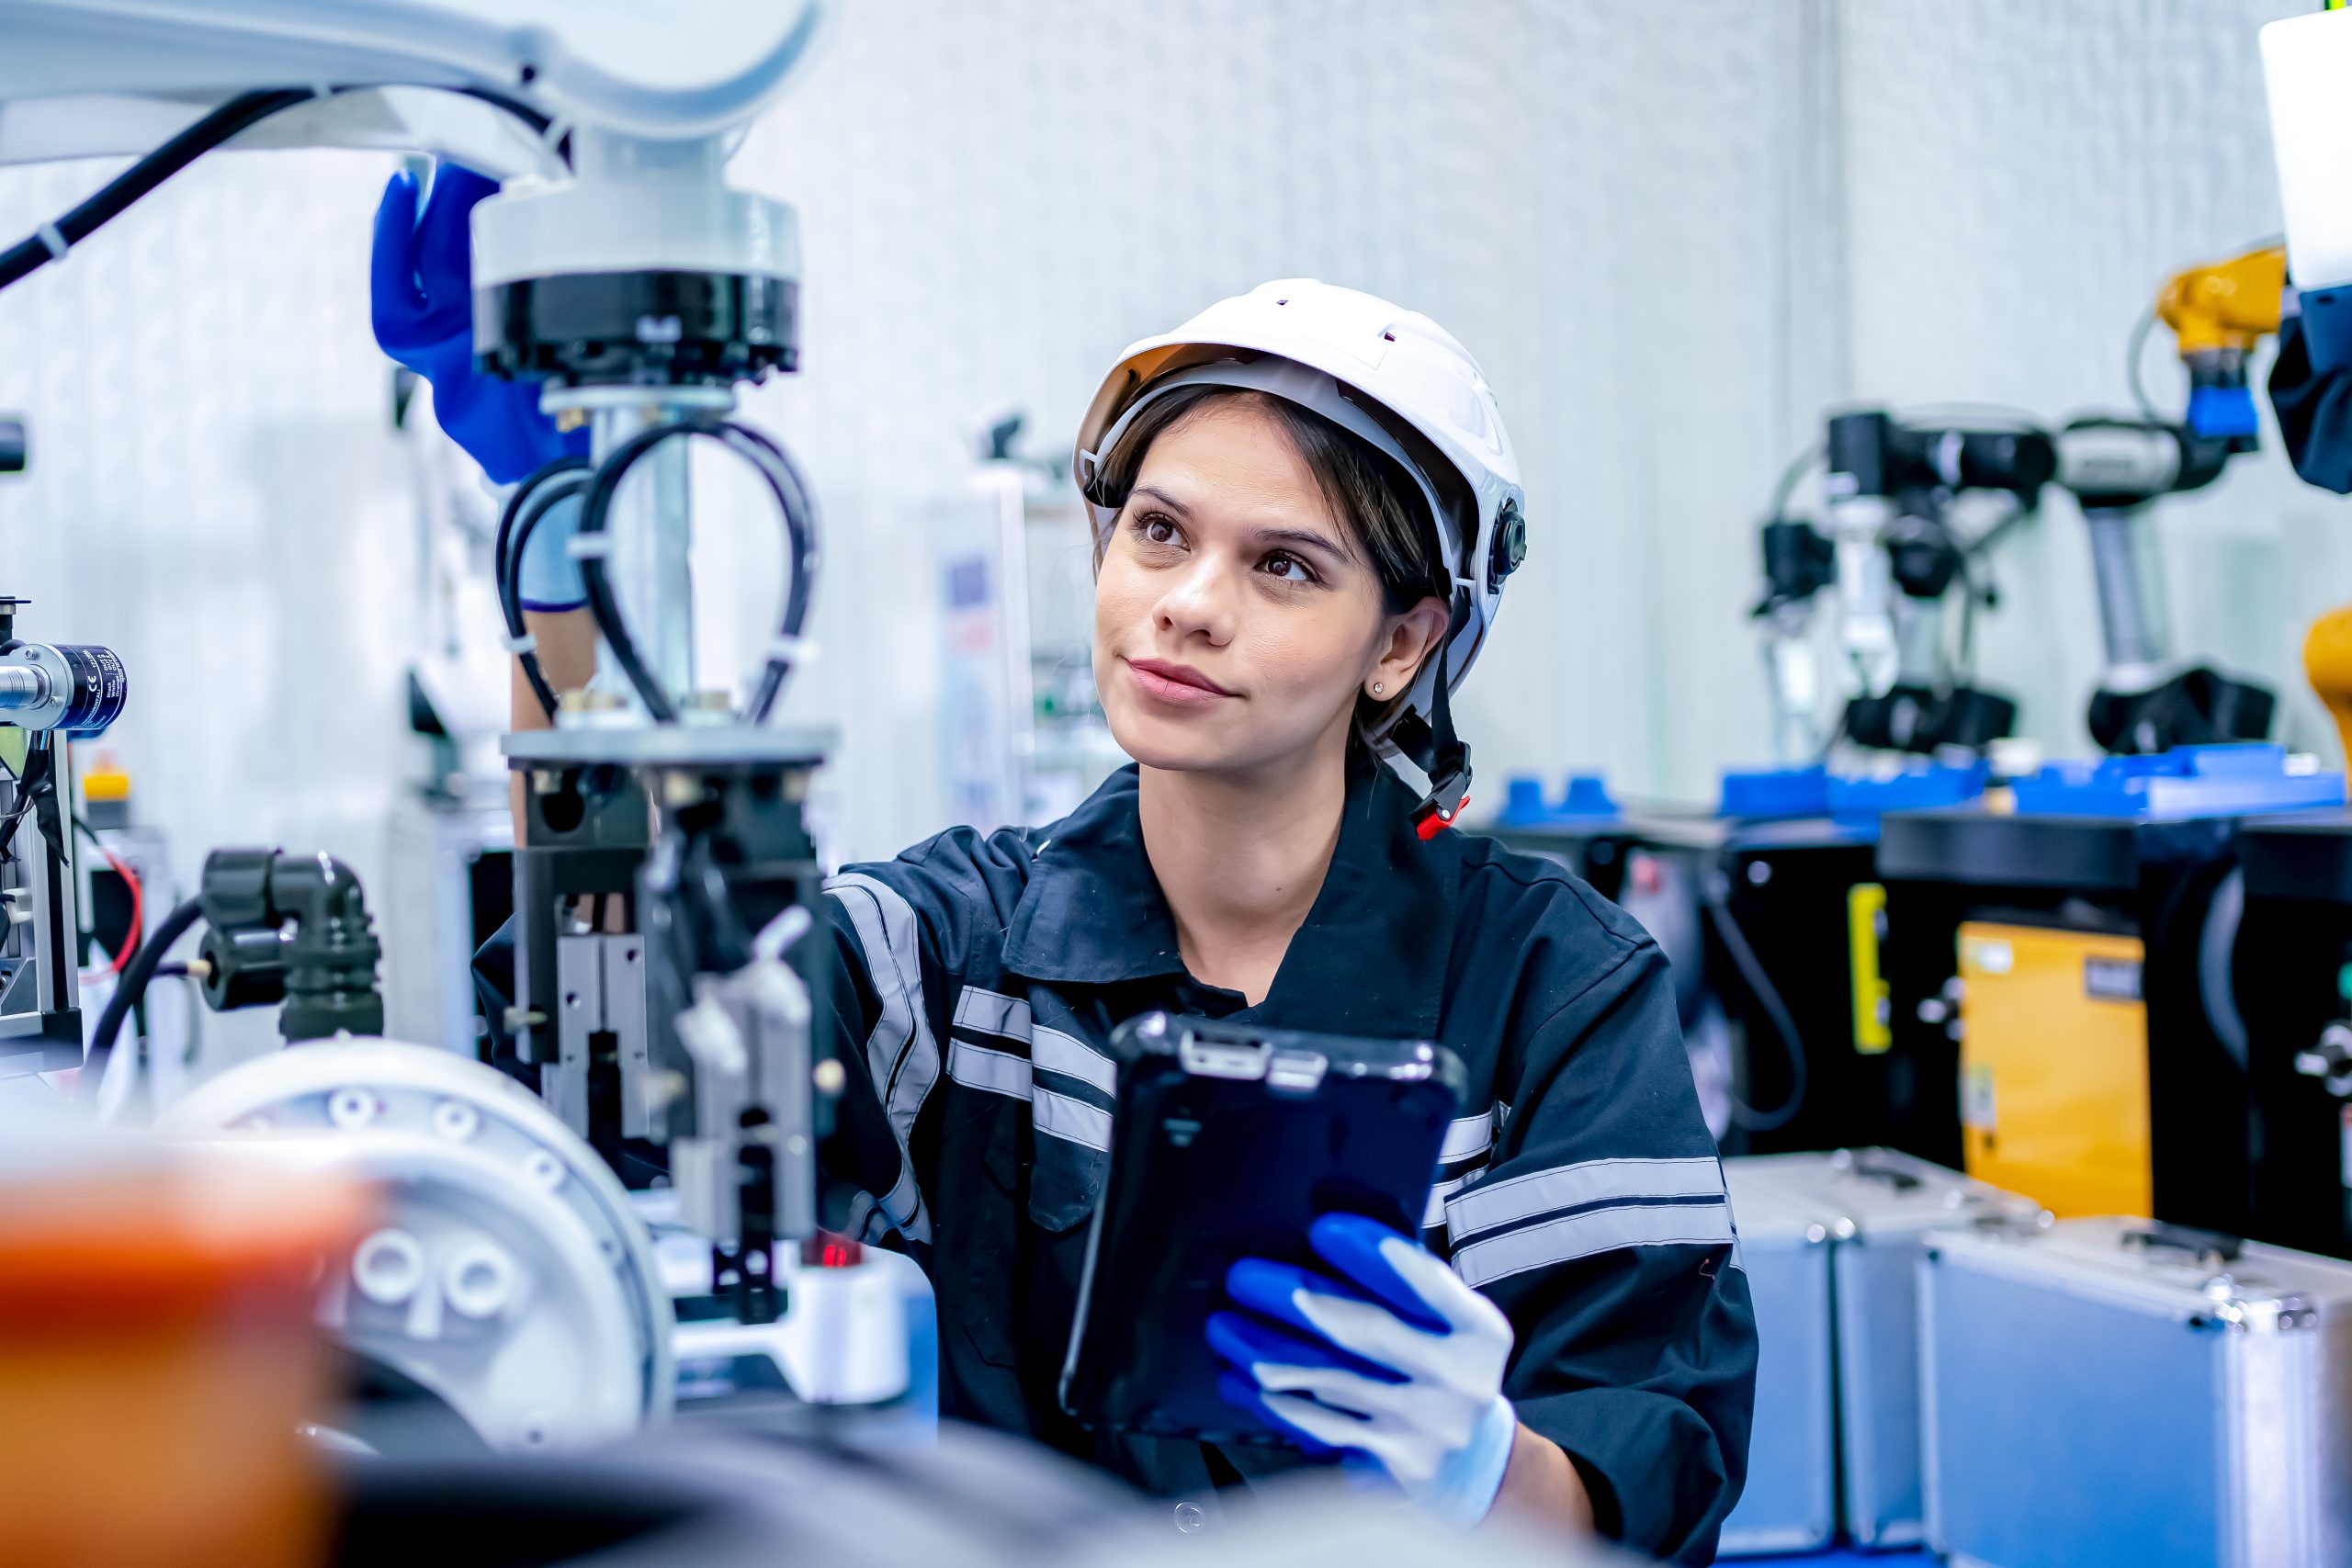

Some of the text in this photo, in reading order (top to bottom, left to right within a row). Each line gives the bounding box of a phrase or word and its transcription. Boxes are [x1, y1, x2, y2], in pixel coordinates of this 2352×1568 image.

[104, 659, 112, 671] OUT
[108, 660, 117, 671] OUT
[87, 675, 97, 693] CE
